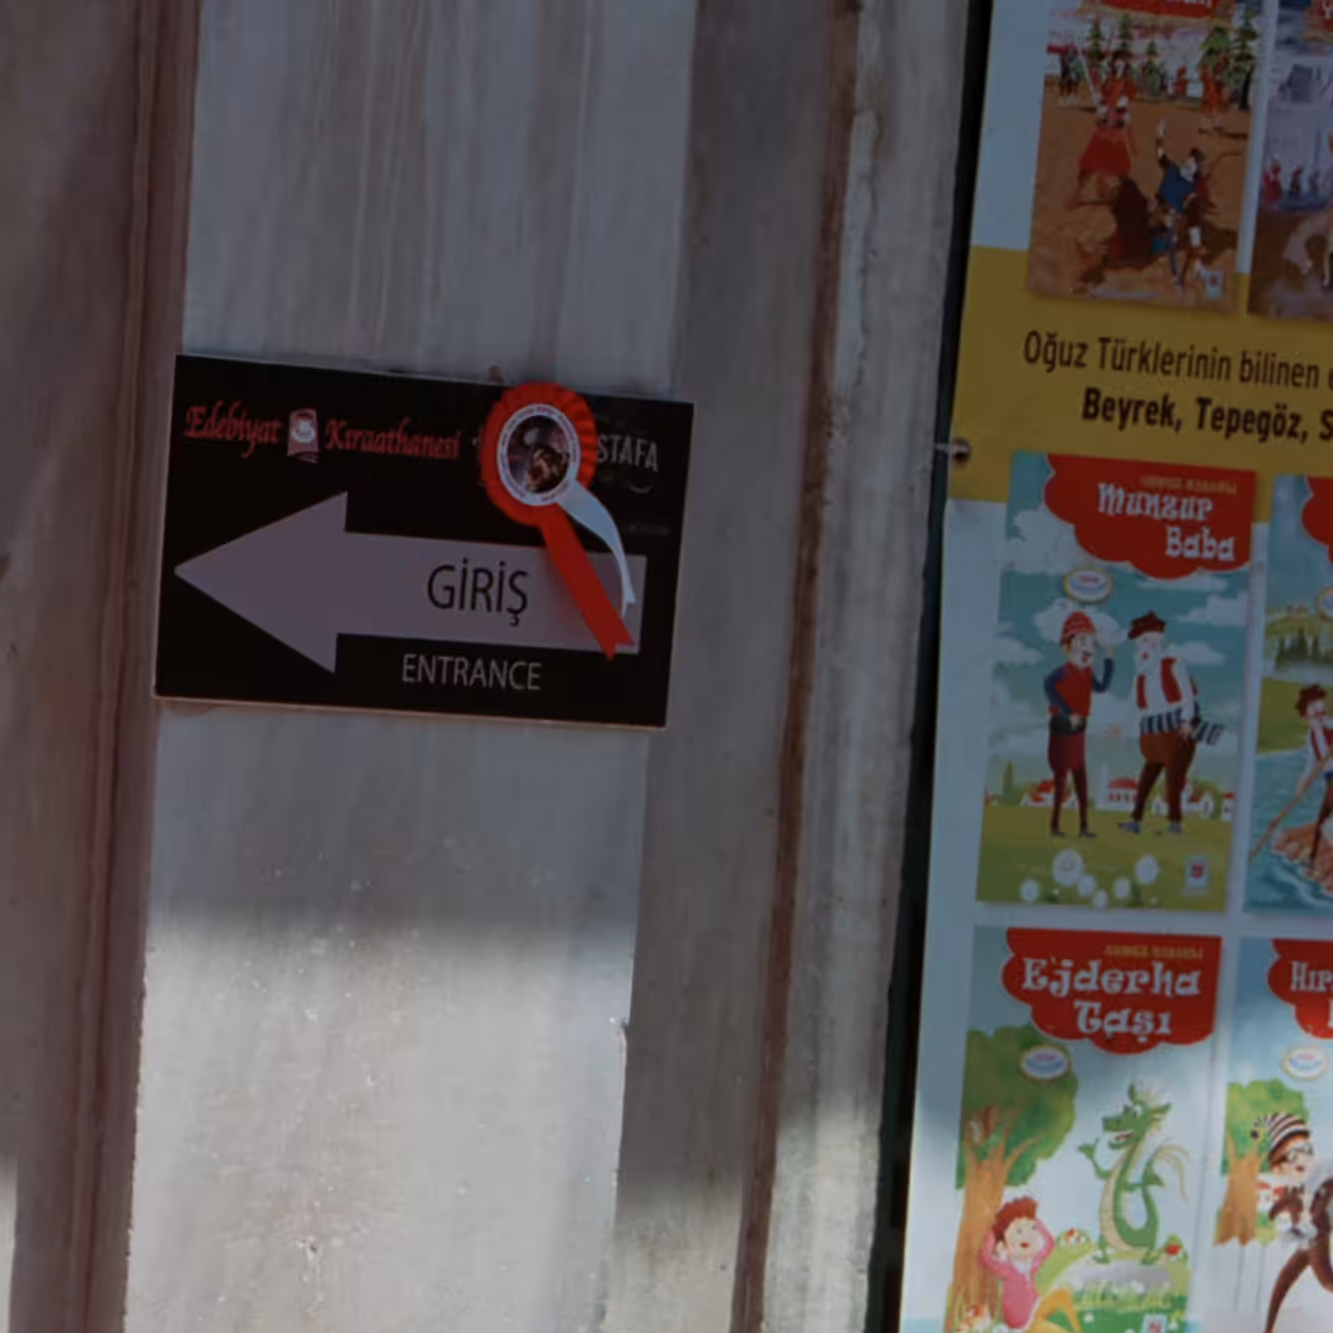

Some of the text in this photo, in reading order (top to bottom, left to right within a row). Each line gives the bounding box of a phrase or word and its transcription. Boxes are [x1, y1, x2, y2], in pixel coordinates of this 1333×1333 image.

[1023, 330, 1089, 373] Oğuz
[1098, 336, 1232, 383] Türklerinin
[1238, 349, 1320, 390] bilinen
[183, 399, 281, 460] Edebiyat
[1081, 387, 1183, 433] Beyrek,
[1196, 396, 1309, 445] Tepegöz,
[595, 435, 660, 474] STAFA
[1165, 526, 1236, 562] Baba
[428, 556, 530, 627] GİRİŞ
[401, 652, 543, 692] ENTRANCE
[1022, 956, 1202, 998] Ejderha
[1073, 999, 1173, 1043] Taşı
